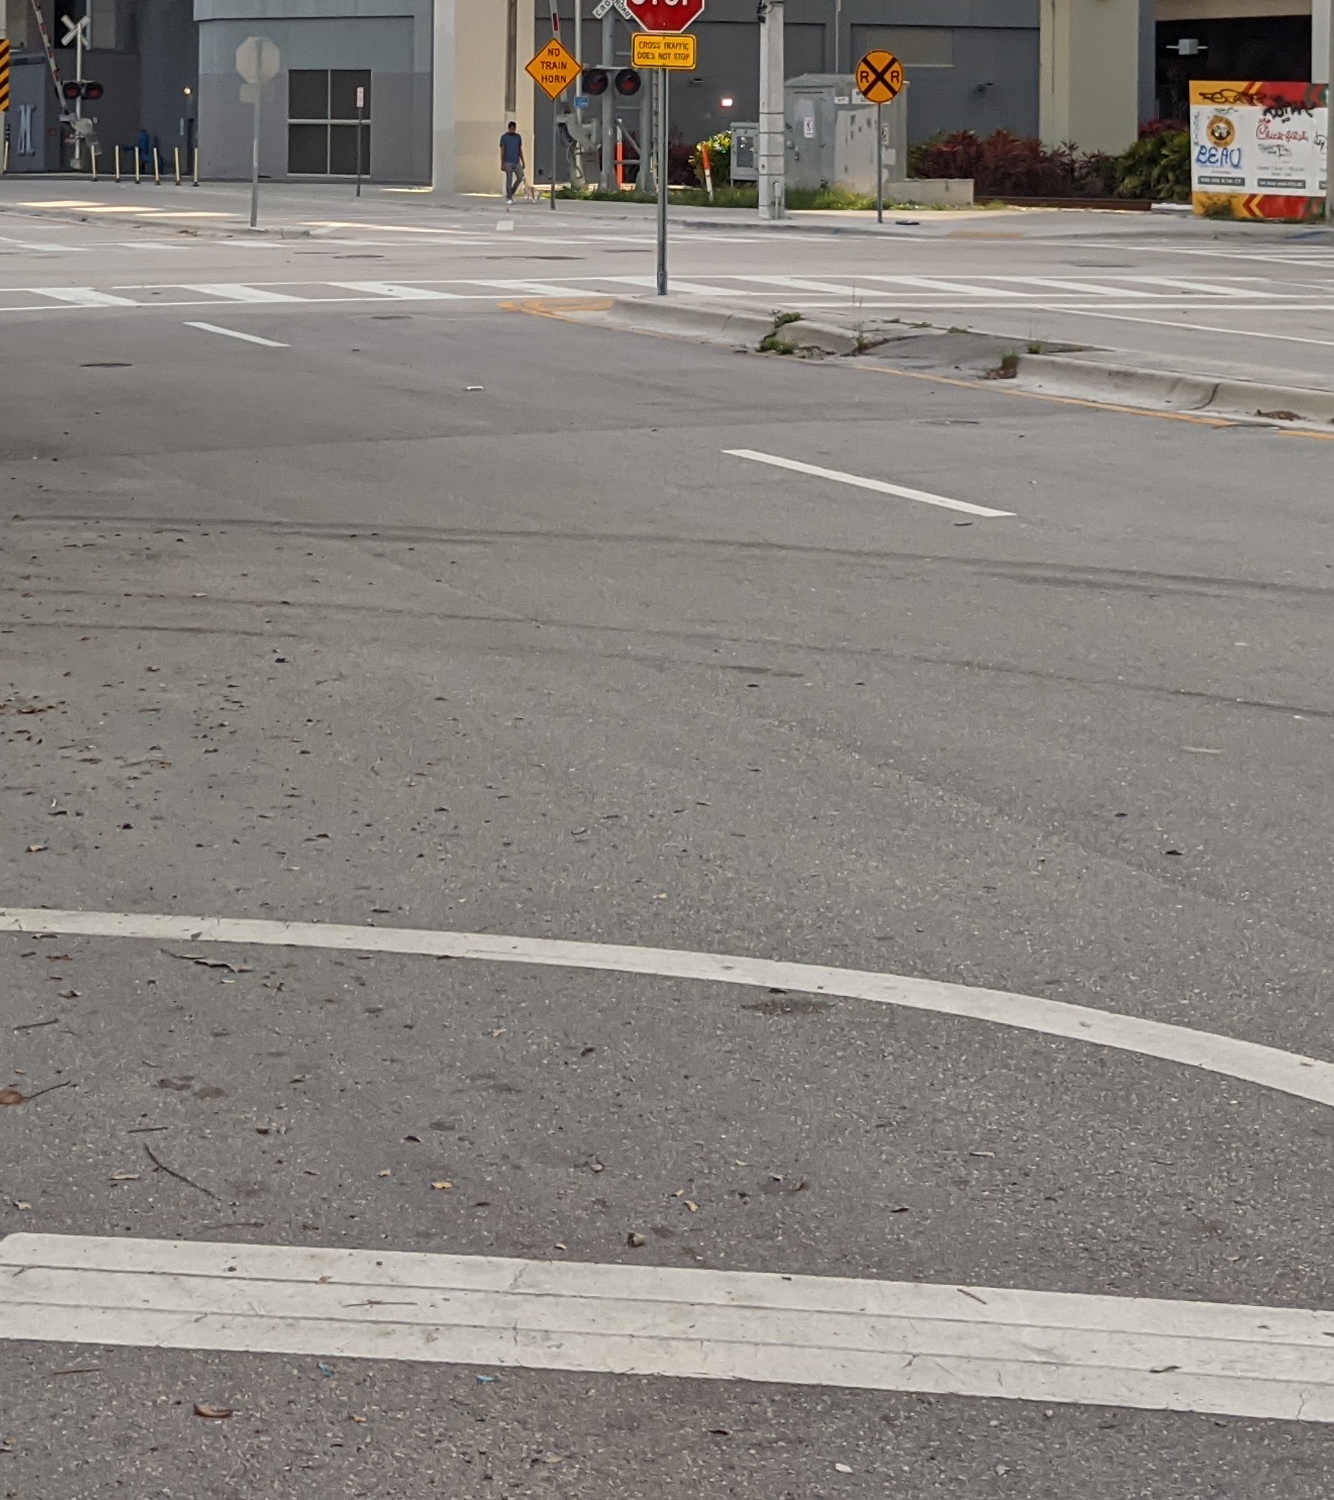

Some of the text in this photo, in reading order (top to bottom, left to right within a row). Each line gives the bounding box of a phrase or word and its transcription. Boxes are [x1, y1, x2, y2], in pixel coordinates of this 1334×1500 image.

[638, 41, 689, 50] CROSS TRAFFIC
[547, 48, 561, 57] NO
[637, 51, 690, 61] DOES NOT STOP
[540, 60, 567, 70] TRAIN
[541, 74, 567, 84] HORN
[860, 70, 900, 84] R R
